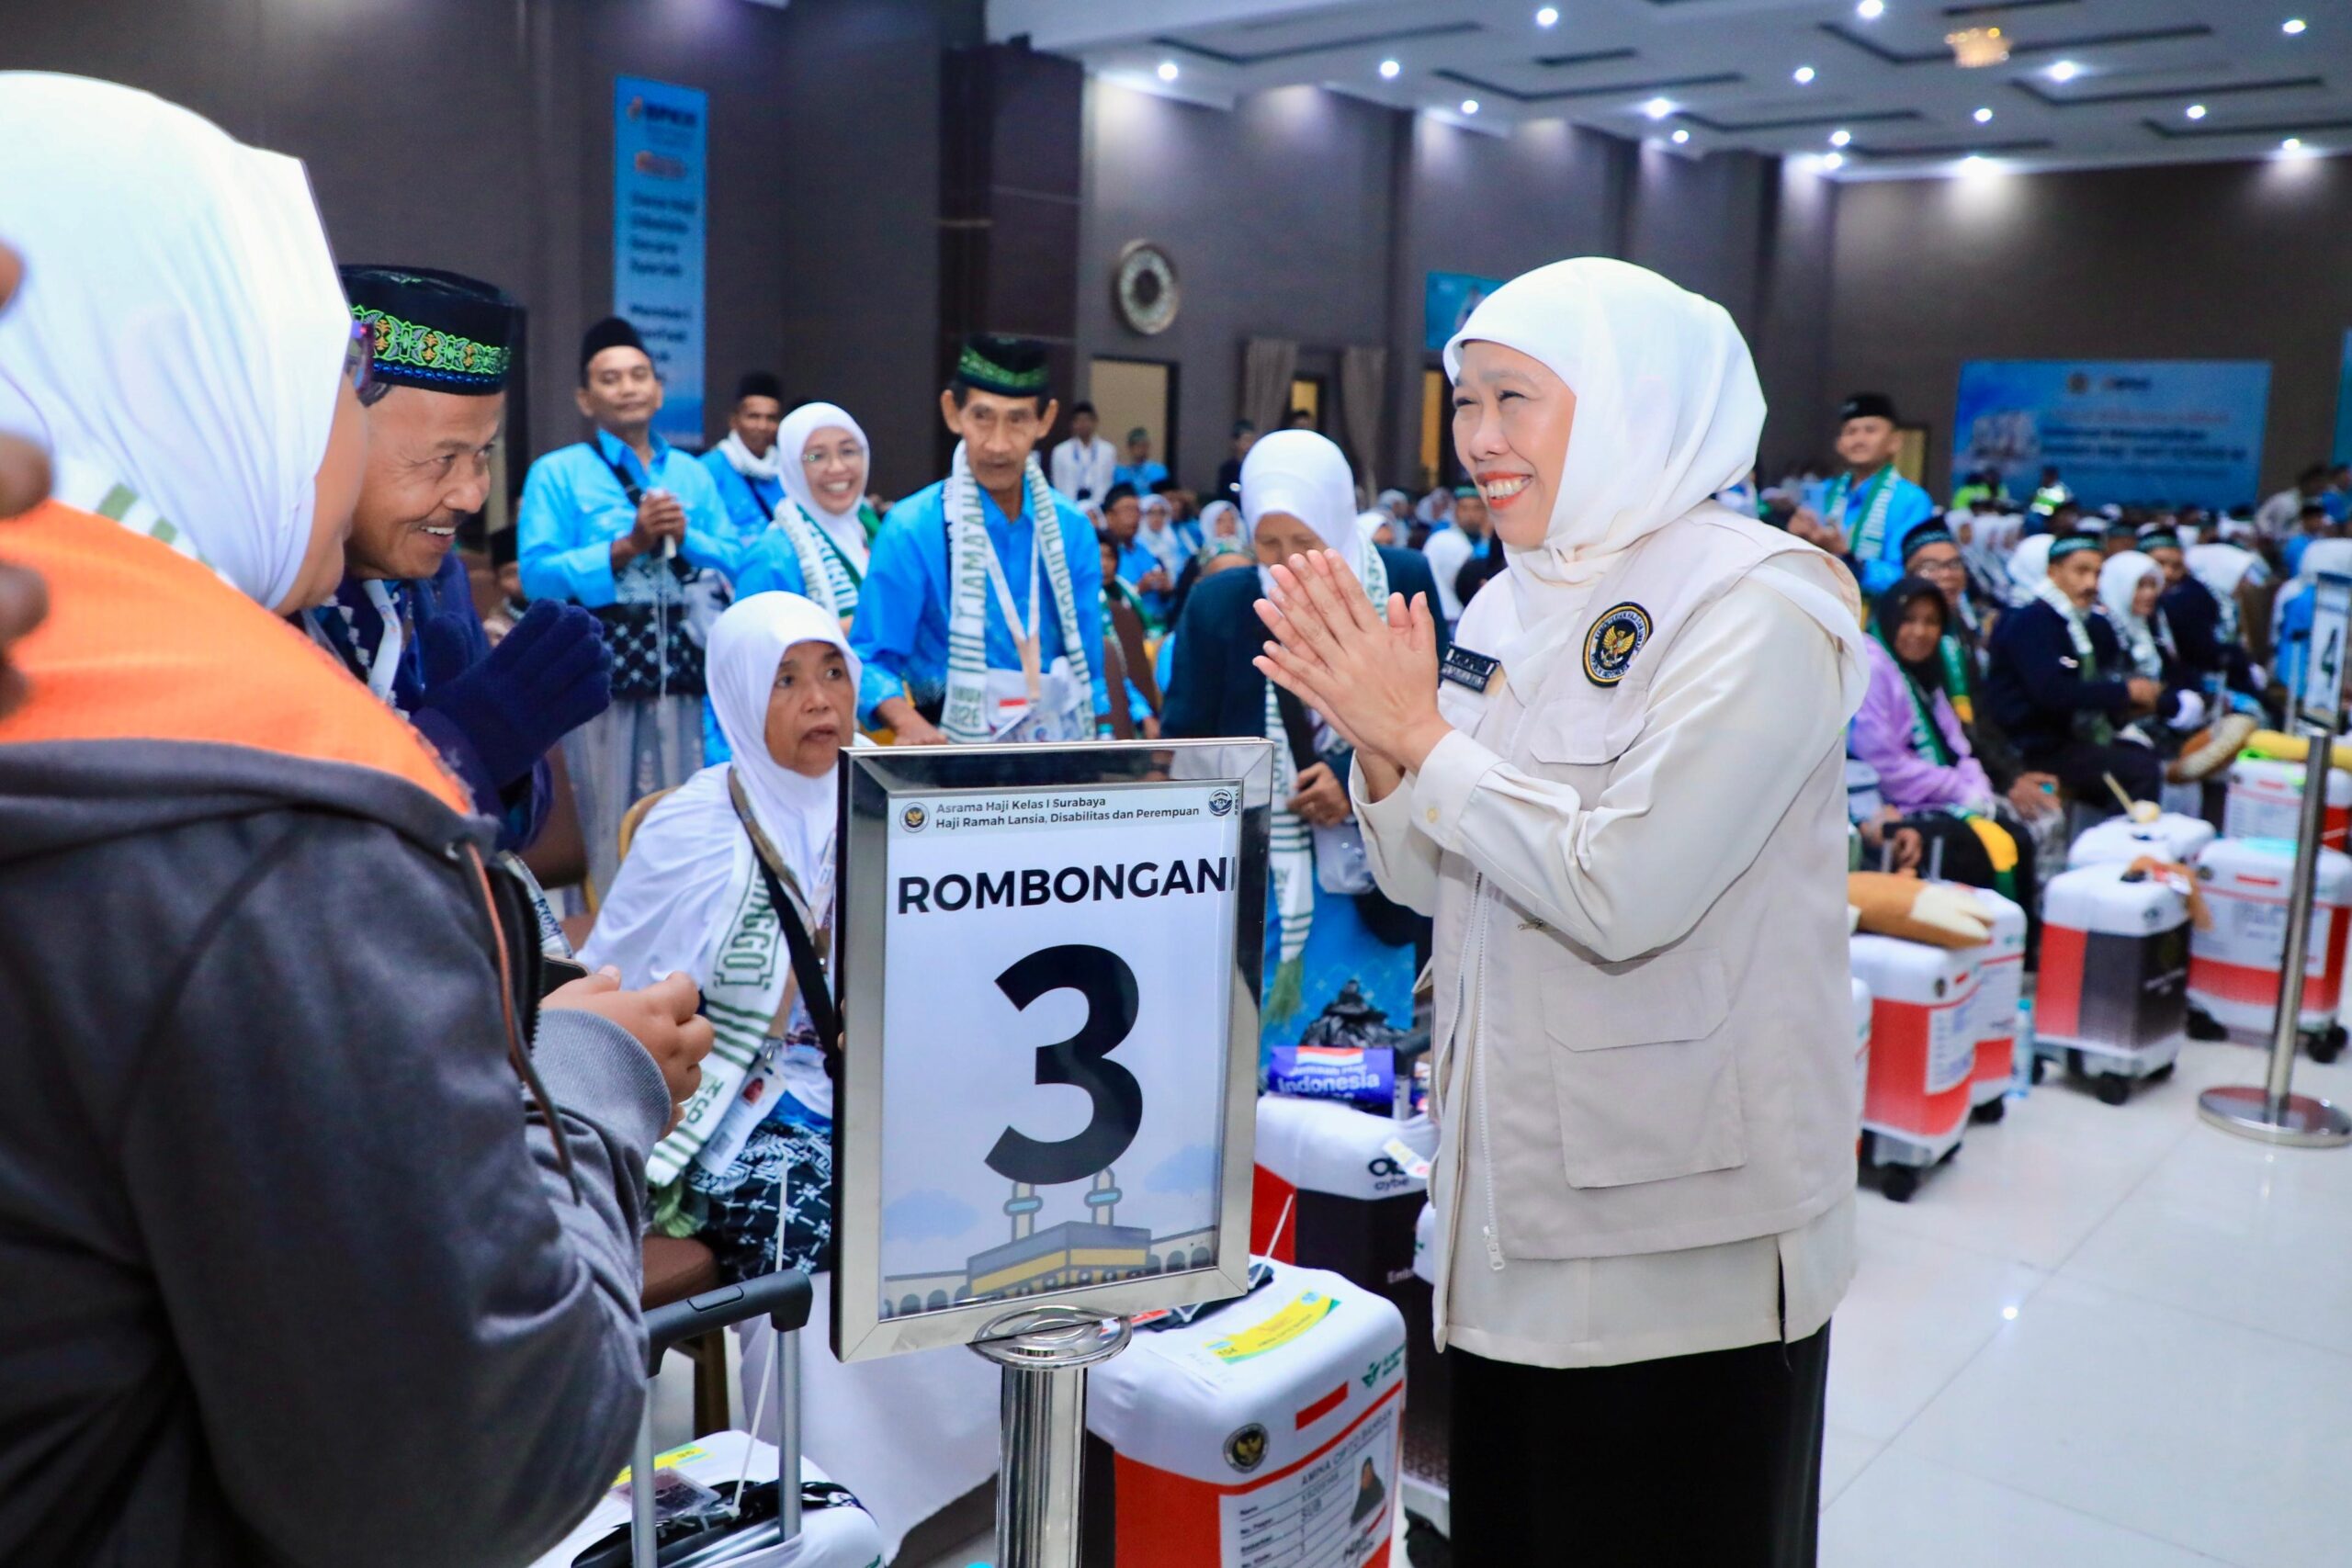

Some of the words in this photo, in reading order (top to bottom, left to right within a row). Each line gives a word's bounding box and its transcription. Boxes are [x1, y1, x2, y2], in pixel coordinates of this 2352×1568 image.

[2322, 627, 2337, 689] 4
[936, 803, 983, 814] Asrama
[986, 800, 1009, 812] Haji
[1012, 799, 1044, 809] Kelas
[1053, 796, 1106, 809] Surabaya
[936, 817, 960, 829] Haji
[963, 815, 1004, 828] Ramah
[1008, 813, 1048, 825] Lansia,
[1051, 810, 1110, 823] Disabilitas
[1113, 809, 1133, 820] dan
[1136, 807, 1200, 819] Perempuan
[898, 857, 1227, 915] ROMBONGAN
[984, 944, 1143, 1184] 3
[1277, 1072, 1381, 1093] Indonesia
